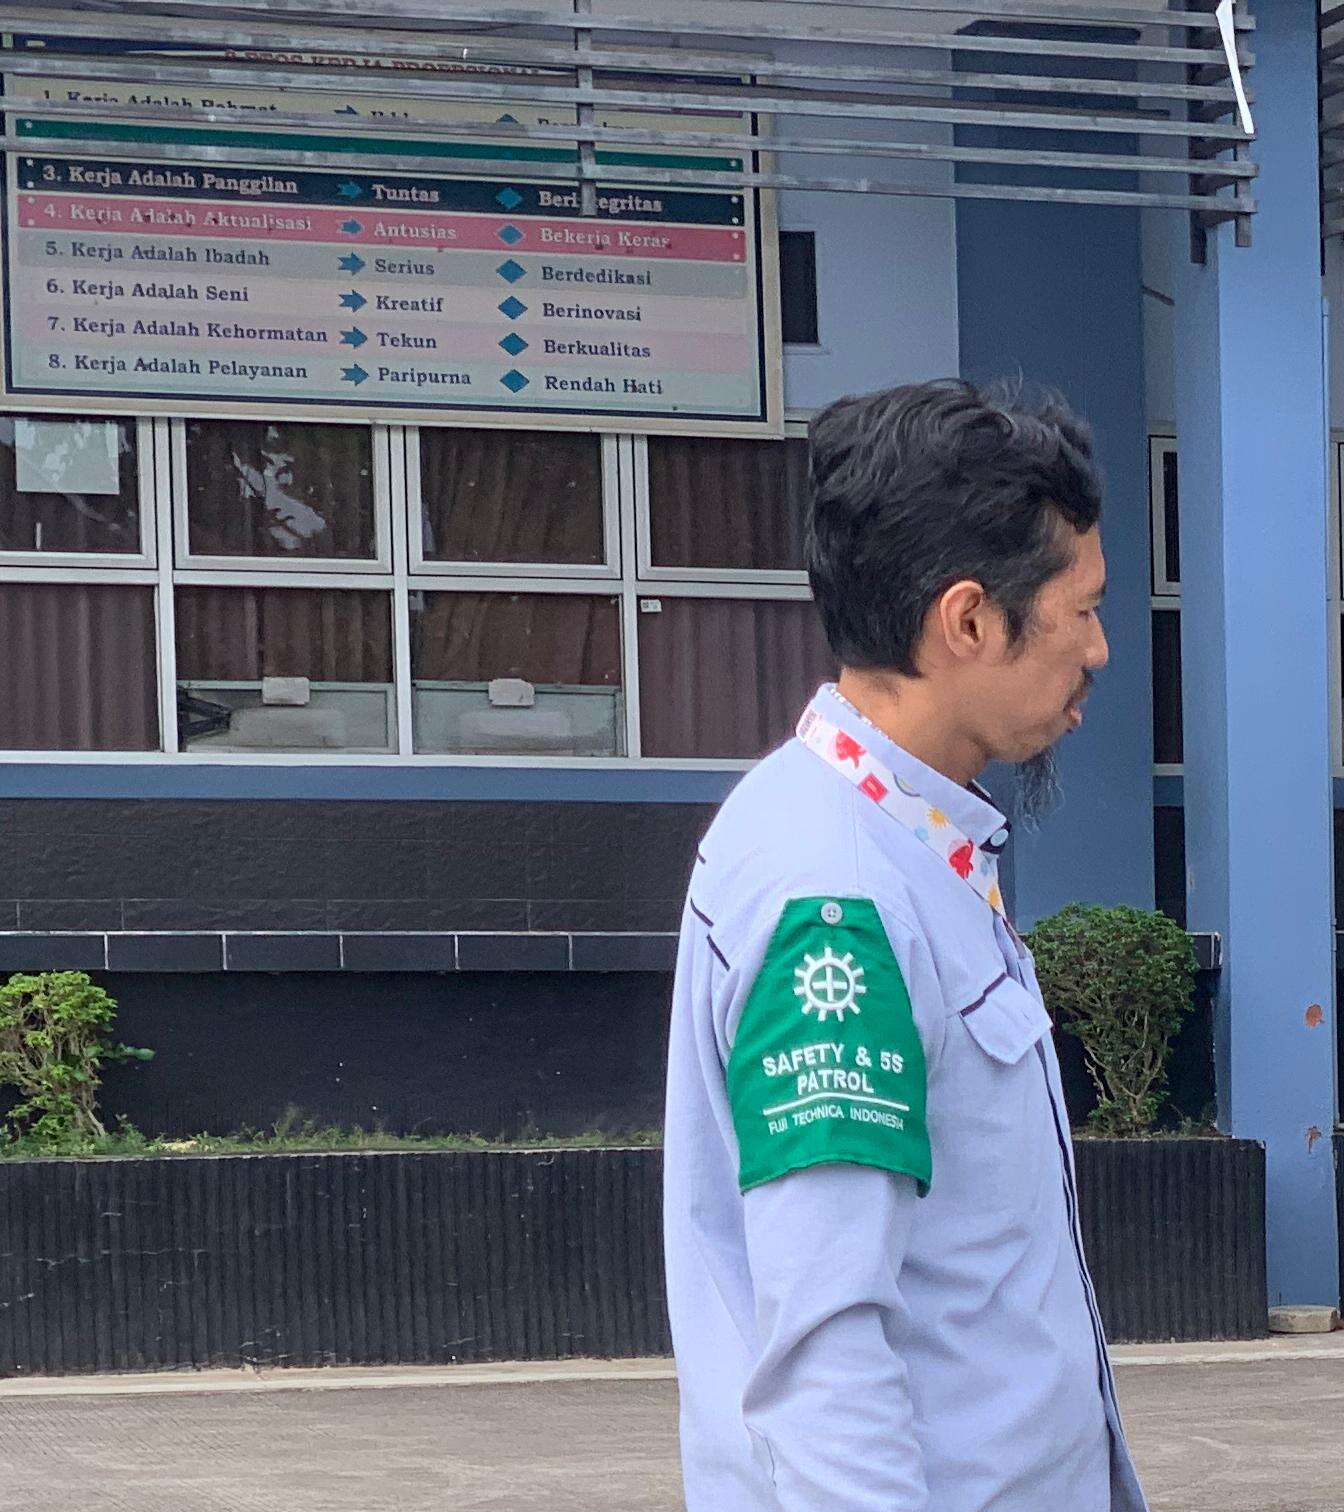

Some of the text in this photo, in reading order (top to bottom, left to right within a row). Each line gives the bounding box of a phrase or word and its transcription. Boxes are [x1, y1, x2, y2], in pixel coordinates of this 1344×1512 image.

[42, 165, 298, 195] 3. Kerja Adalah Panggilan
[371, 184, 440, 202] Tuntas
[538, 190, 663, 214] Beriegritas
[44, 204, 312, 231] 4. Kerja Adalah Aktualisasi
[374, 222, 457, 240] Antusias
[540, 228, 671, 248] Bekerja Keras
[45, 241, 271, 266] 5. Kerja Adalah Ibadah
[374, 258, 435, 275] Serius
[542, 266, 651, 285] Berdedikasi
[46, 279, 249, 302] 6. Kerja Adalah Seni
[376, 295, 444, 312] Kreatif
[543, 303, 642, 322] Berinovasi
[47, 316, 328, 342] 7. Kerja Adalah Kehormatan
[377, 333, 437, 349] Tekun
[544, 340, 651, 358] Berkualitas
[48, 354, 308, 380] 8. Kerja Adalah Pelayanan
[378, 367, 472, 387] Paripurna
[544, 376, 663, 394] Rendah Hati
[762, 1042, 904, 1076] SAFETY & 5S
[797, 1069, 875, 1095] PATROL
[768, 1104, 904, 1135] FUJI TECHNICA INDONESIA
